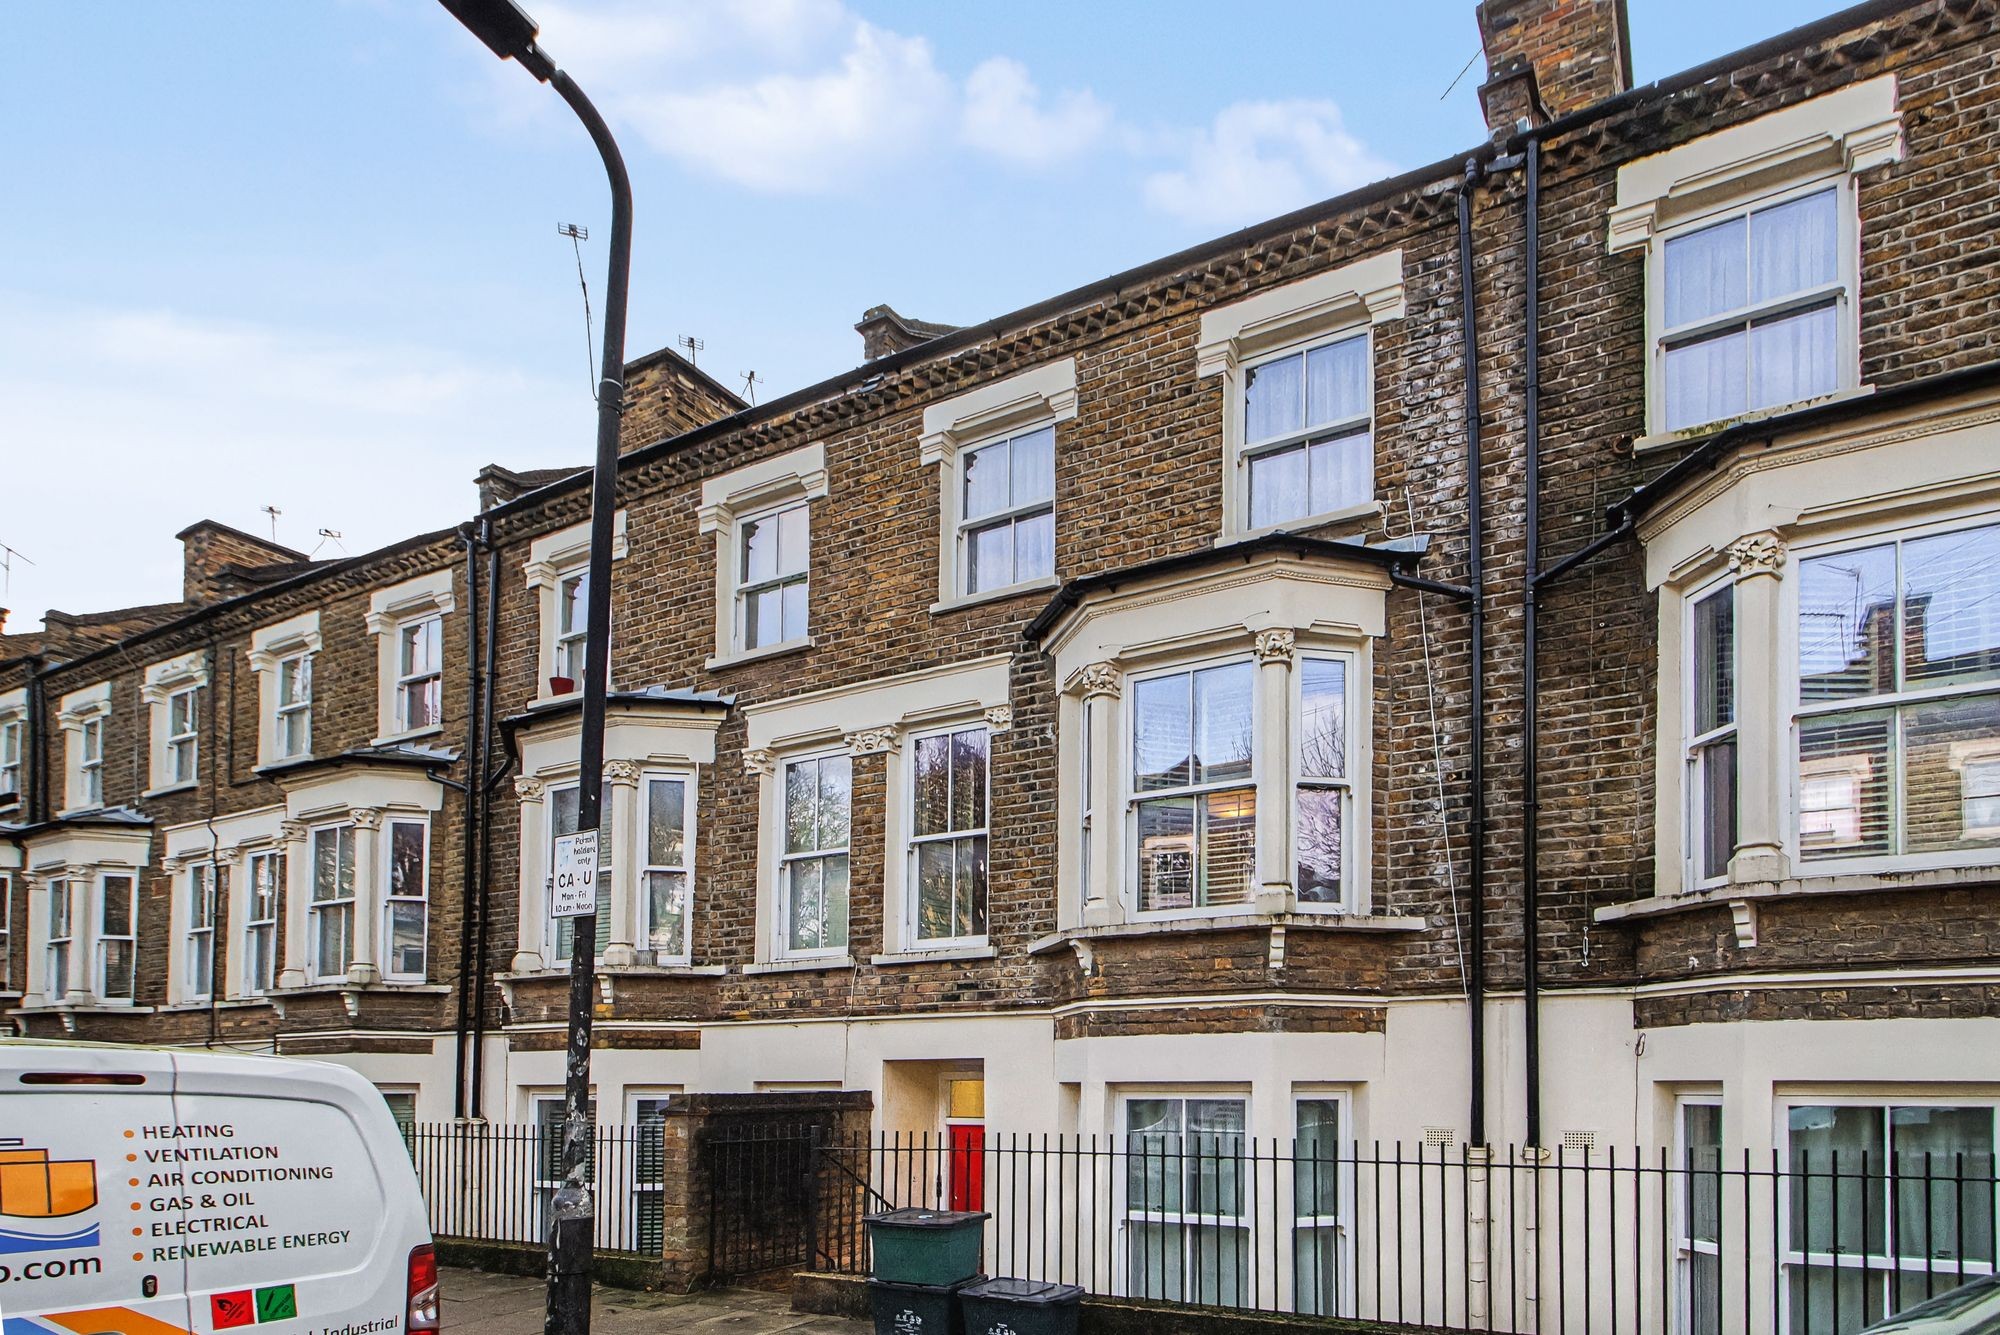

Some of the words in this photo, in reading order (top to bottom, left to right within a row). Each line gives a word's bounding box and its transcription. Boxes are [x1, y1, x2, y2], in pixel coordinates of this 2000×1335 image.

[142, 1124, 234, 1140] HEATING
[144, 1146, 279, 1163] VENTILATION
[147, 1173, 185, 1188] AIR
[191, 1166, 334, 1185] CONDITIONING
[149, 1195, 194, 1212] GAS
[200, 1194, 217, 1209] &
[223, 1192, 255, 1207] OIL
[151, 1214, 269, 1237] ELECTRICAL
[152, 1236, 277, 1262] RENEWABLE
[283, 1230, 350, 1249] ENERGY
